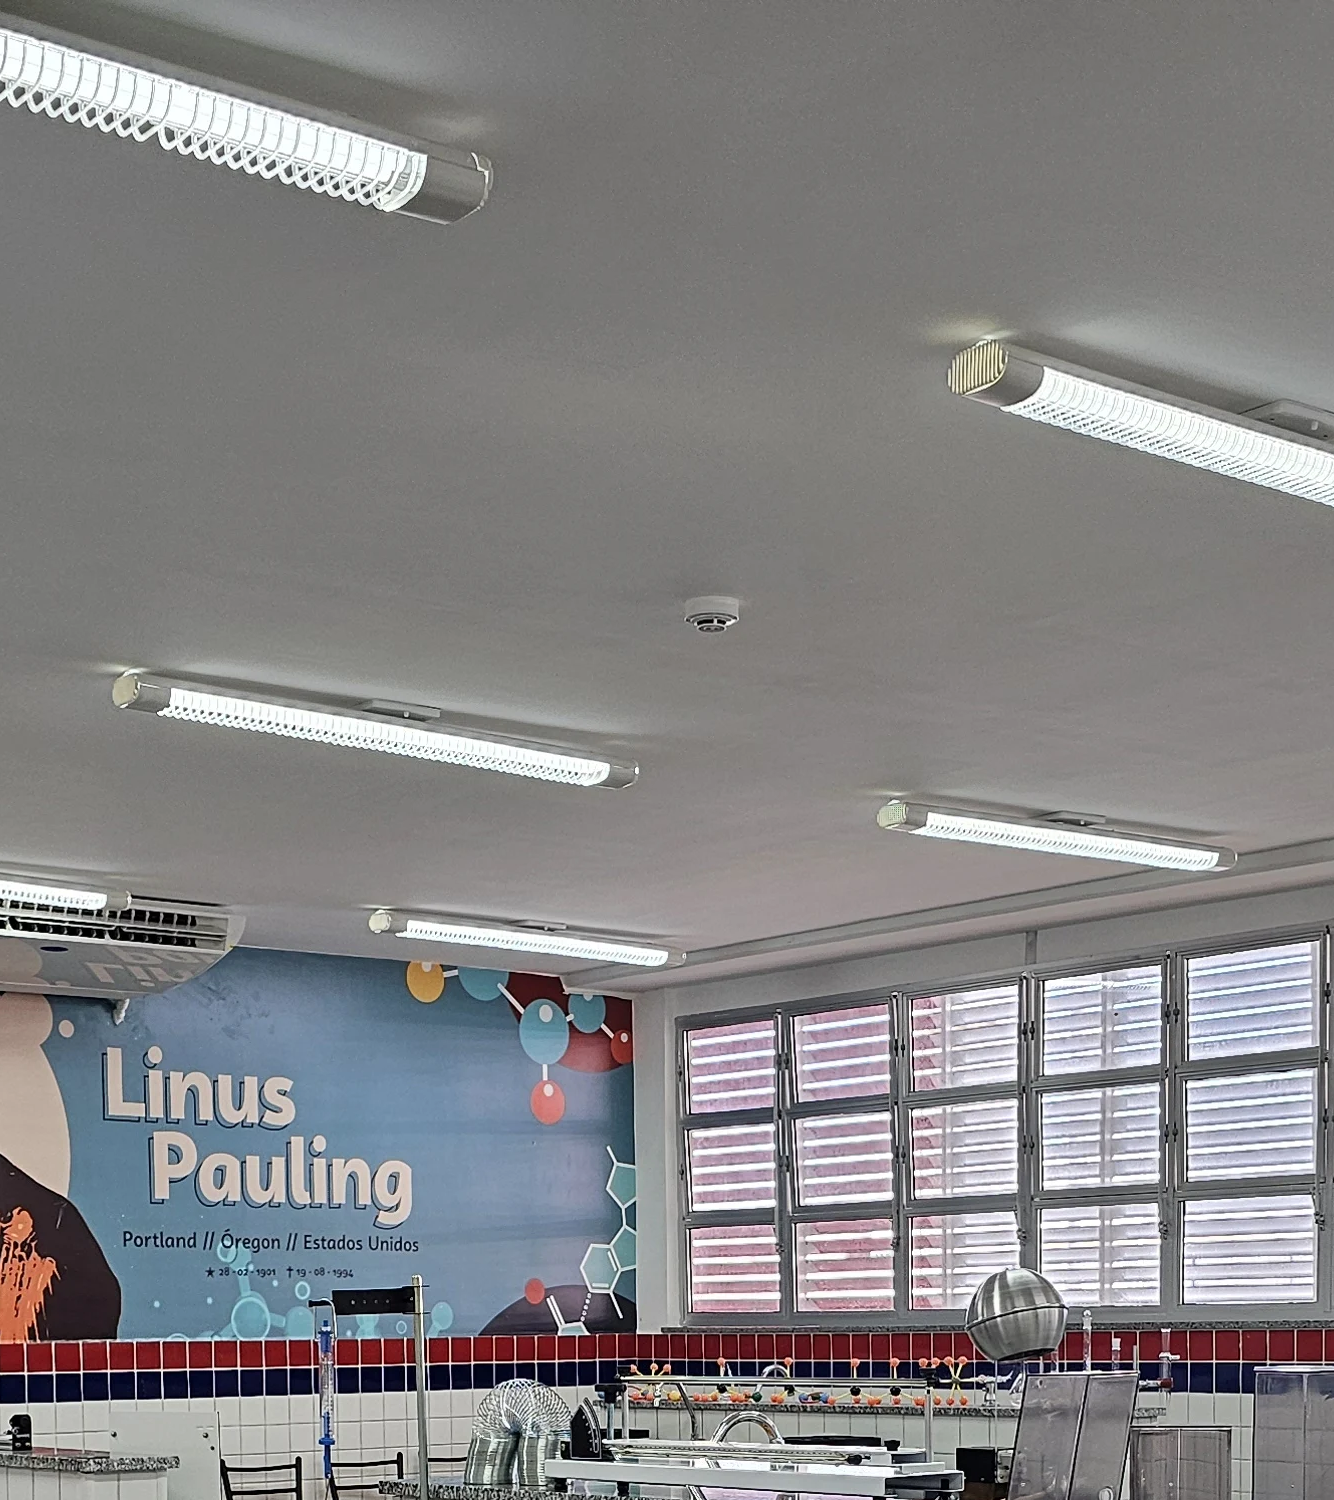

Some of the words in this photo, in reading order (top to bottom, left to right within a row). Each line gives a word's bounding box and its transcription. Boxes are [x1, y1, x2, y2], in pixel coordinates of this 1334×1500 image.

[102, 1044, 296, 1130] Linus
[149, 1133, 414, 1228] Pauling
[122, 1230, 197, 1250] Portland
[203, 1232, 215, 1251] //
[221, 1228, 281, 1254] Óregon
[286, 1233, 298, 1252] //
[303, 1234, 364, 1251] Estados
[368, 1235, 419, 1253] Unidos
